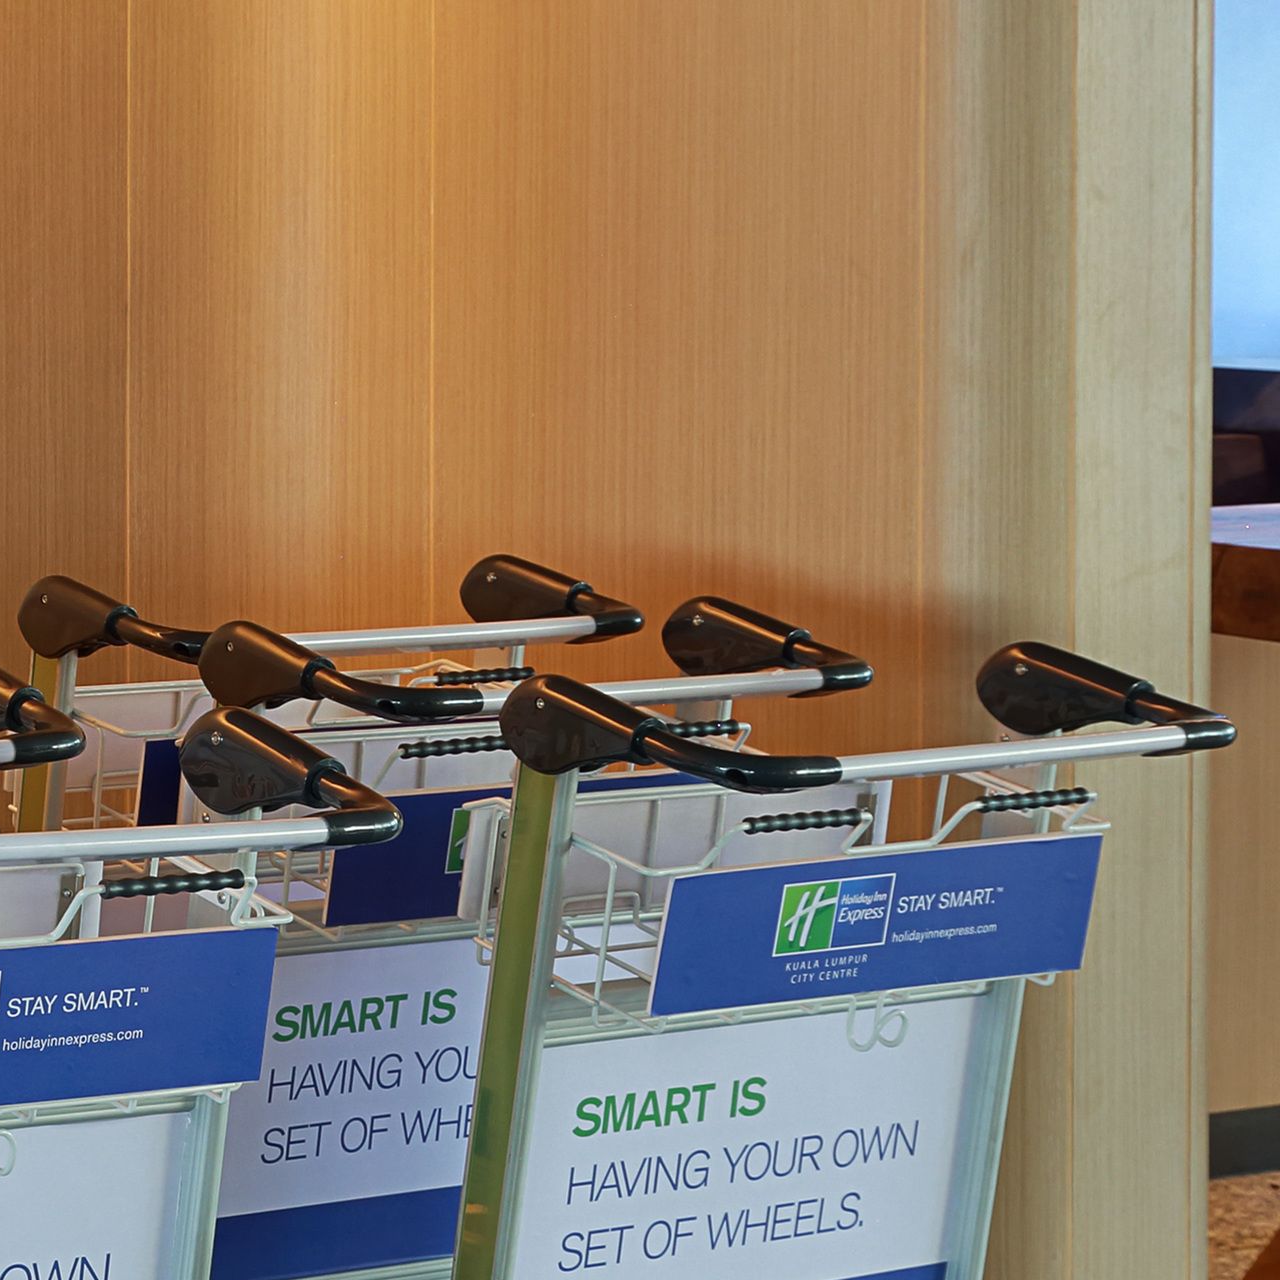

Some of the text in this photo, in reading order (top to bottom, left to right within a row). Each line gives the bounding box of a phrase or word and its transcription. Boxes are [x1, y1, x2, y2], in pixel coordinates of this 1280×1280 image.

[841, 891, 887, 905] Holiday Inn
[897, 894, 936, 913] STAY
[837, 906, 885, 925] Express
[786, 954, 867, 971] KUALA LUMPUR
[790, 968, 858, 984] CITY CENTRE
[7, 995, 58, 1017] STAY
[272, 989, 457, 1042] SMART IS
[2, 1029, 143, 1051] holidayinnexpress.com
[268, 1053, 403, 1103] HAVING
[572, 1077, 767, 1137] SMART IS
[261, 1121, 332, 1164] SET
[341, 1114, 391, 1153] OF
[567, 1120, 919, 1205] HAVING YOUR OWN
[558, 1192, 863, 1272] SET OF WHEELS.
